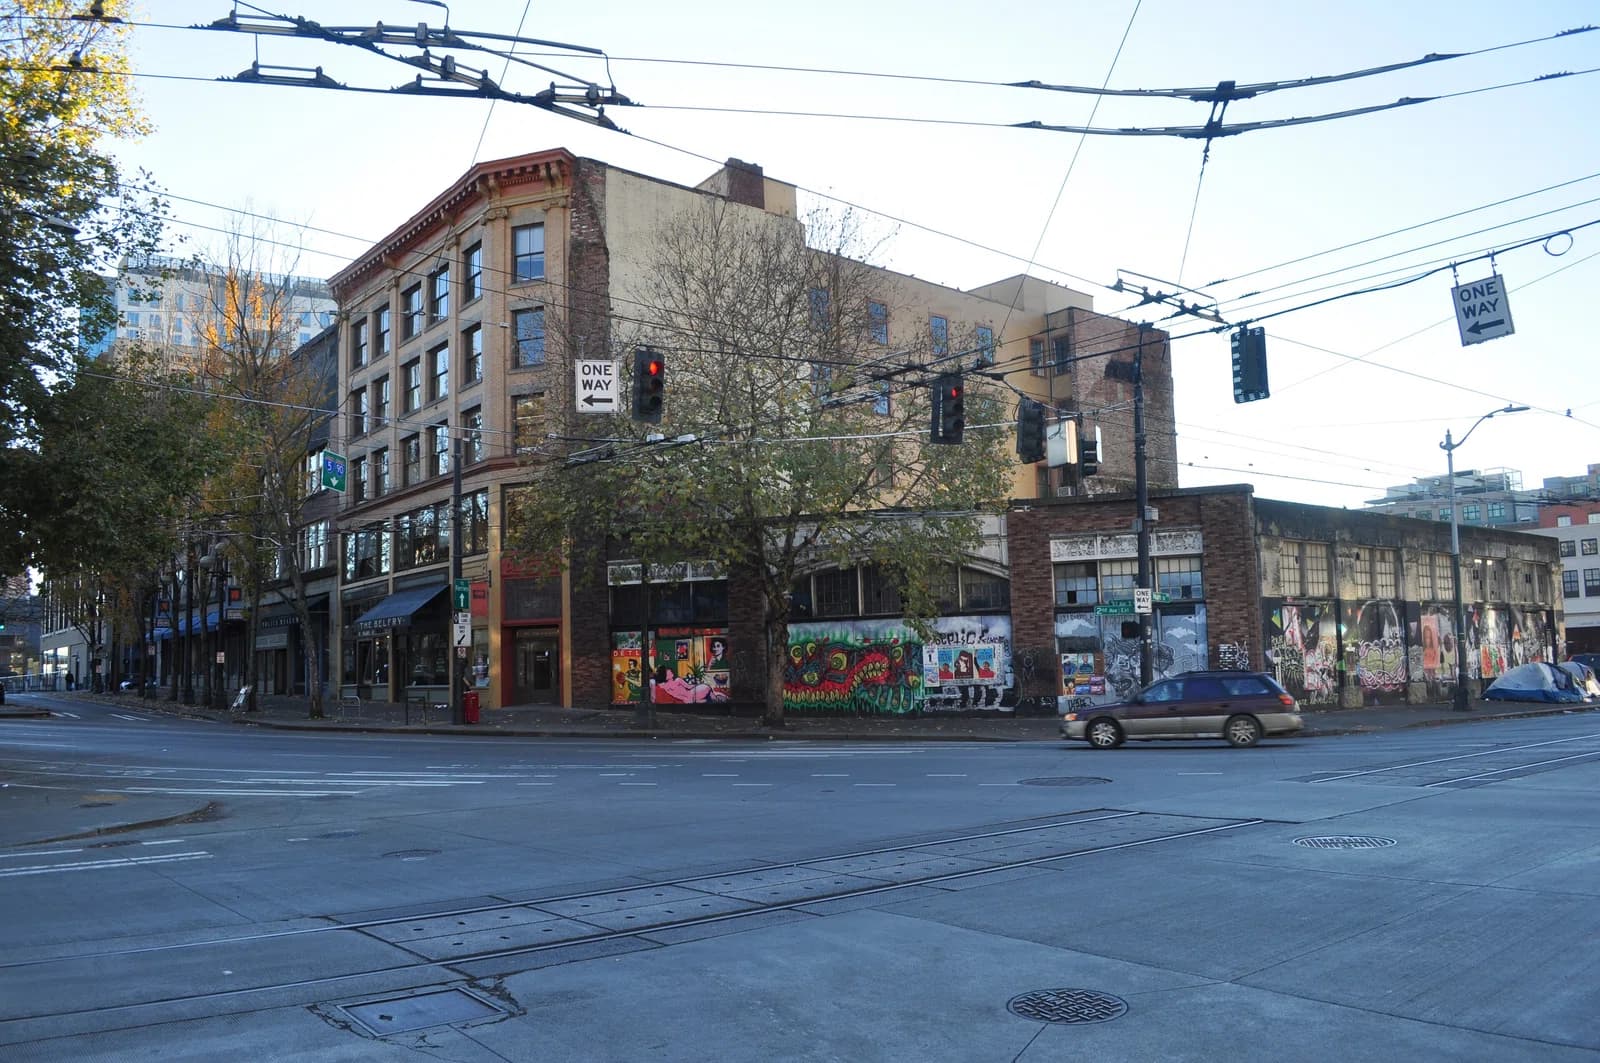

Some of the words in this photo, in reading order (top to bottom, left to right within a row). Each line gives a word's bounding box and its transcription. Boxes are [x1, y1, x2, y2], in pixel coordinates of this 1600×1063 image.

[1460, 281, 1498, 302] ONE
[1462, 298, 1499, 319] WAY
[582, 364, 612, 376] ONE
[582, 379, 612, 391] WAY
[327, 461, 332, 471] 5
[336, 464, 344, 474] 90
[359, 620, 372, 630] THE
[373, 617, 402, 628] BELFRY
